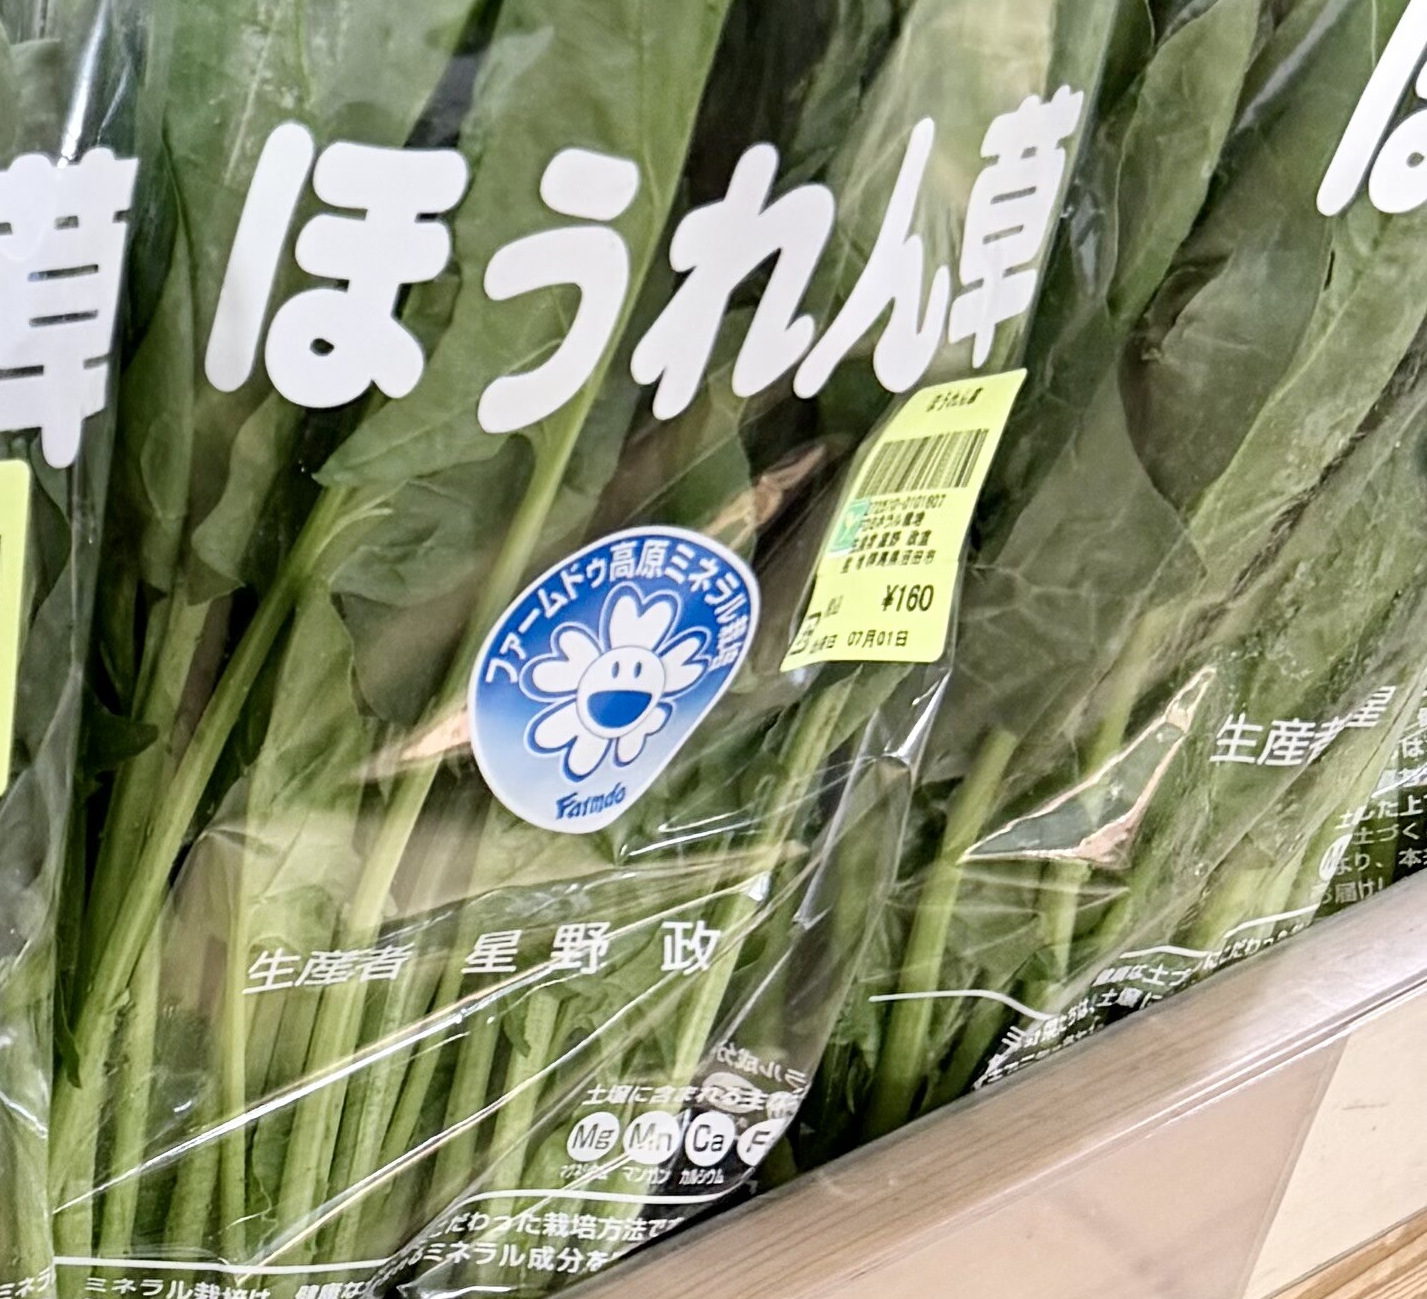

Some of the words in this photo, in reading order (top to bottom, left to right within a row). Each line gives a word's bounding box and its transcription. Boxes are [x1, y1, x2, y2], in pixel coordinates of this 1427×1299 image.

[205, 84, 1084, 438] ほうれん草
[882, 584, 935, 612] ¥160
[847, 630, 909, 648] 07月01日
[555, 782, 627, 820] Farmdo
[242, 941, 413, 996] 生産者
